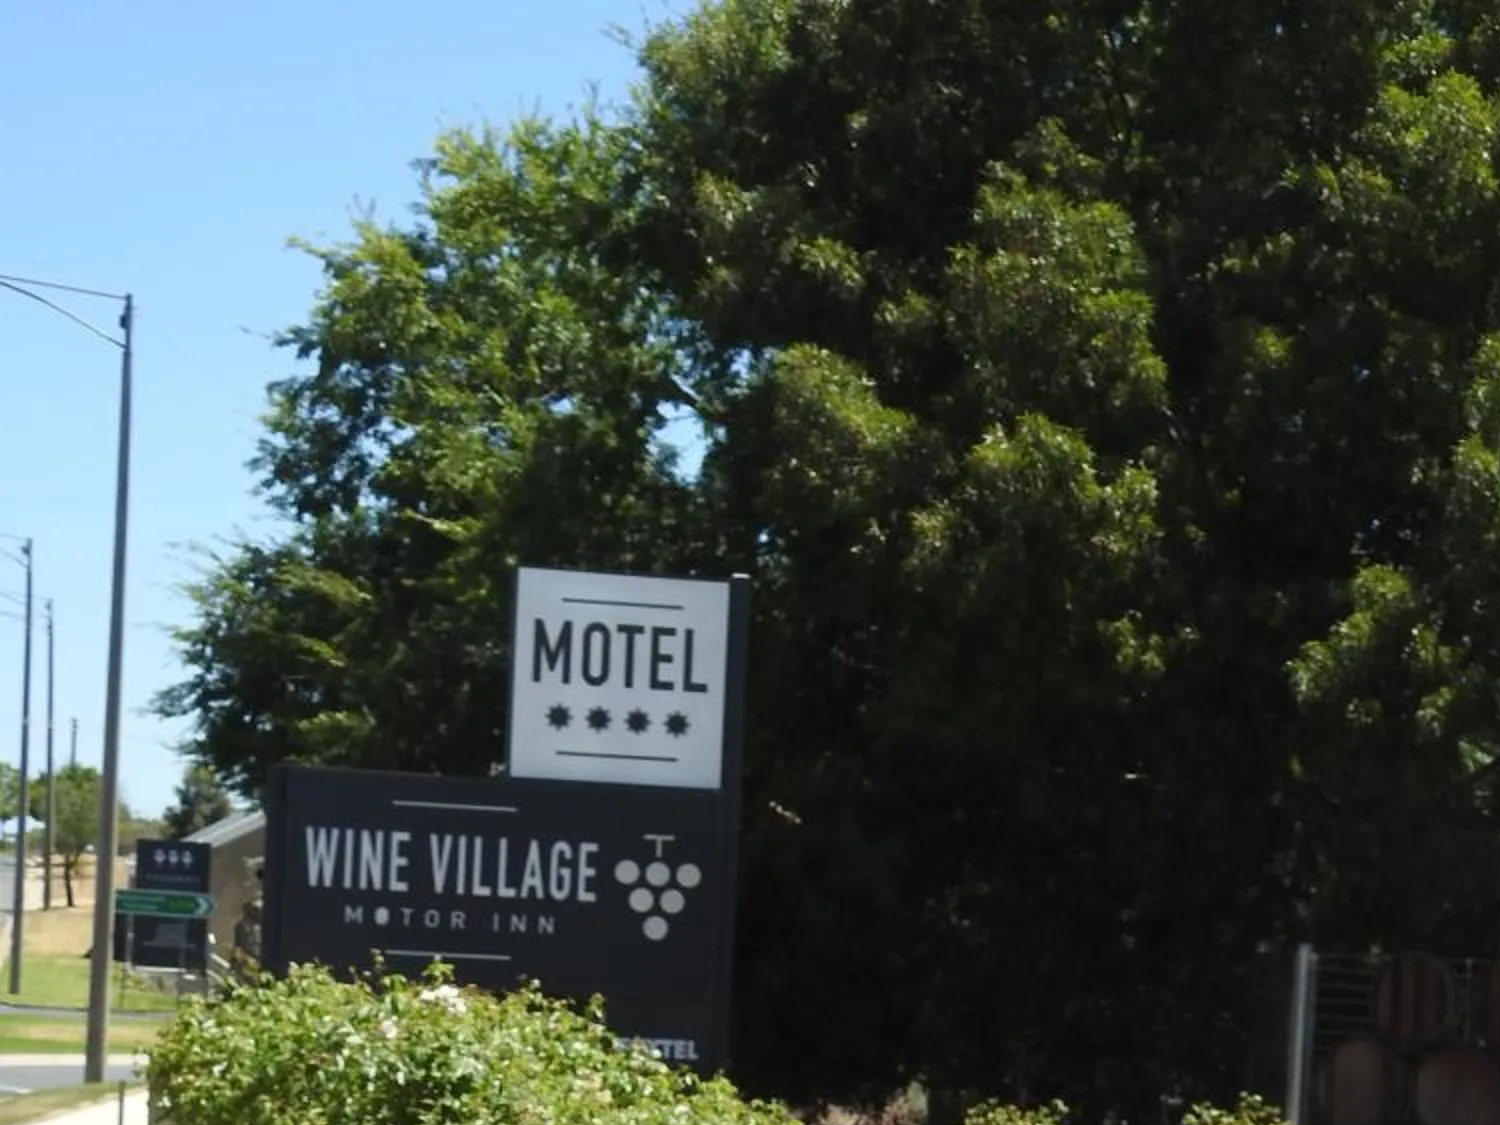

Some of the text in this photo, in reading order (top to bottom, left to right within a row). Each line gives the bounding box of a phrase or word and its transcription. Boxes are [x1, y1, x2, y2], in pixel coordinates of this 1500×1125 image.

[532, 618, 708, 693] MOTEL
[305, 825, 600, 902] WINE VILLAGE
[344, 905, 555, 935] MOTOR INN
